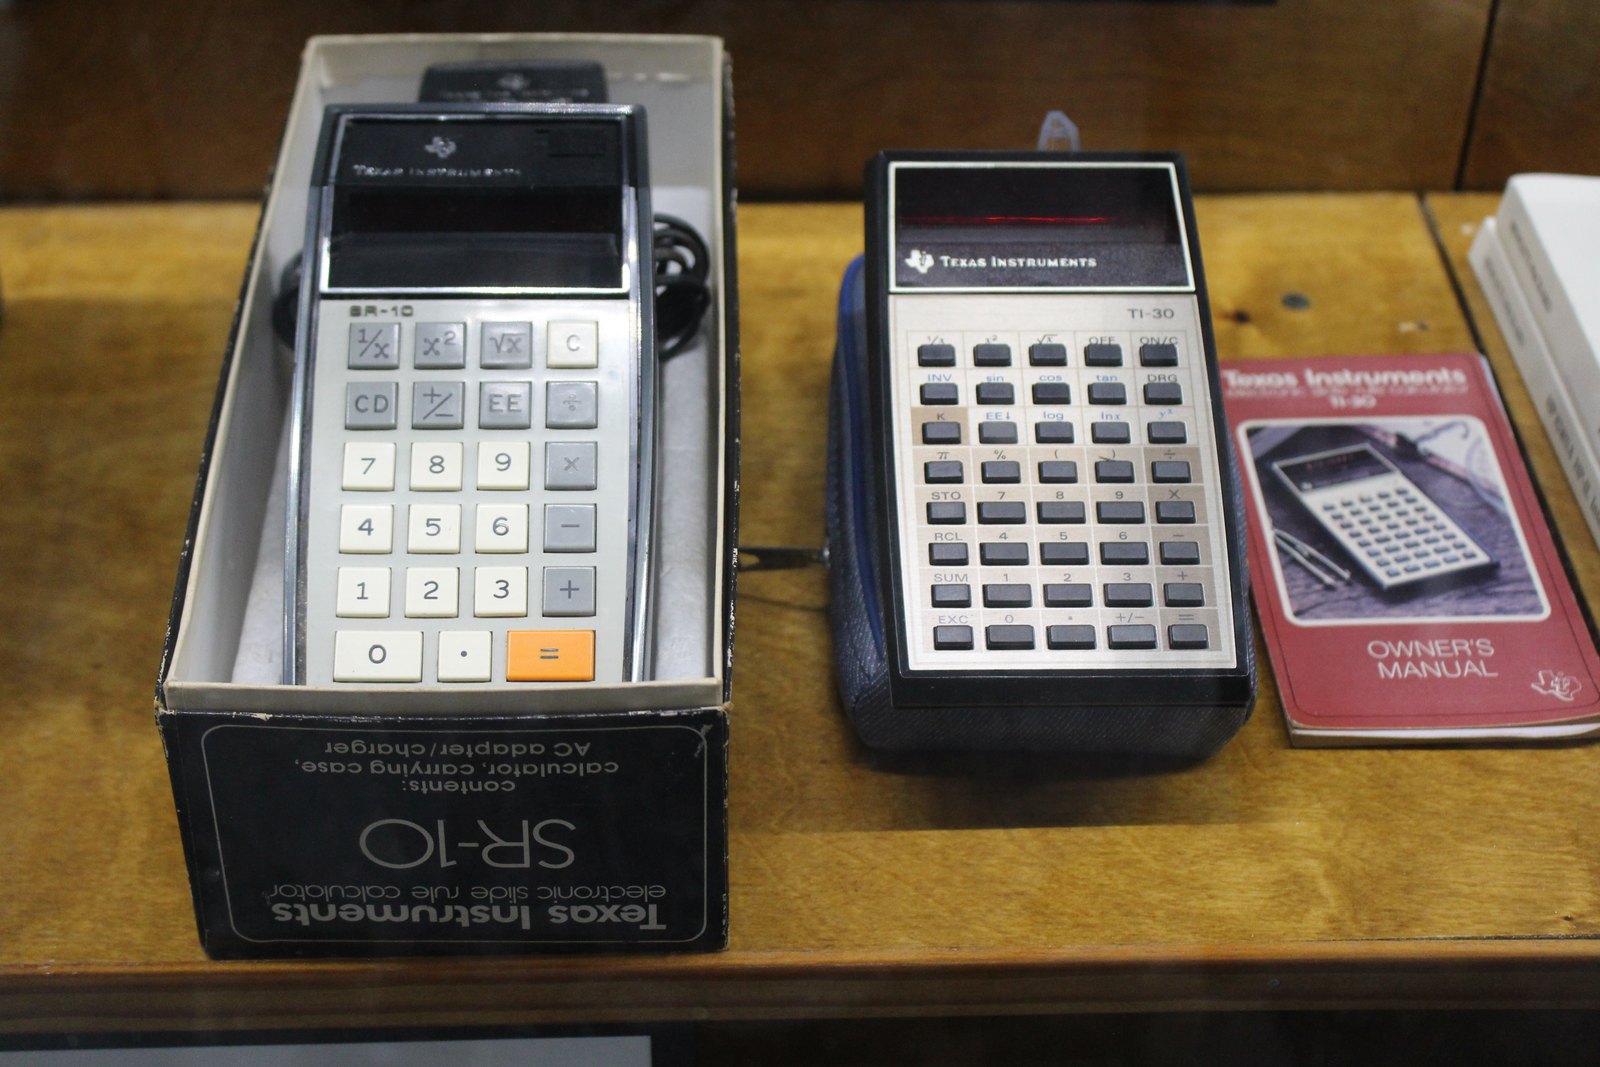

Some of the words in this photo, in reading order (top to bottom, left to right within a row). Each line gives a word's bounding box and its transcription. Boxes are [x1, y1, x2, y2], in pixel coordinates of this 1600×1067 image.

[940, 256, 986, 268] TEXAS
[991, 256, 1097, 268] INSTRUMENTS
[350, 305, 414, 317] SR-10
[1128, 308, 1174, 320] TI-30
[566, 334, 581, 352] C
[1088, 336, 1116, 345] OFF
[1139, 336, 1178, 346] ON/C
[927, 374, 952, 382] INV
[986, 374, 1004, 383] sin
[1039, 374, 1062, 382] cos
[1096, 374, 1118, 382] tan
[1147, 374, 1178, 383] DRG
[354, 394, 389, 414] CD
[488, 394, 522, 413] EE
[936, 412, 945, 420] K
[1043, 410, 1064, 422] log
[360, 458, 376, 475] 7
[428, 455, 446, 474] 8
[494, 453, 512, 472] 9
[931, 490, 962, 500] STO
[998, 491, 1006, 500] 7
[1055, 490, 1064, 500] 8
[1114, 490, 1124, 500] 9
[358, 518, 374, 536] 4
[425, 518, 441, 536] 5
[492, 516, 510, 536] 6
[934, 532, 964, 542] RCL
[999, 532, 1008, 540] 4
[1059, 531, 1068, 540] 5
[1118, 531, 1128, 540] 6
[934, 572, 969, 582] SUM
[1002, 573, 1010, 582] 1
[1063, 572, 1072, 582] 2
[1122, 572, 1132, 582] 3
[356, 582, 368, 600] 1
[424, 580, 440, 600] 2
[492, 579, 510, 599] 3
[938, 614, 969, 624] EXC
[1367, 638, 1495, 659] OWNER'S
[1377, 660, 1498, 679] MANUAL
[554, 742, 592, 756] AC
[294, 760, 363, 773] case,
[370, 760, 475, 778] carrying
[482, 762, 620, 777] calculator,
[402, 780, 516, 794] contents:
[359, 818, 576, 870] SR-10
[270, 884, 401, 902] calculator
[412, 886, 460, 904] rule
[470, 885, 529, 904] slide
[536, 884, 666, 902] electronic
[271, 902, 530, 930] Instruments
[548, 904, 667, 930] Texas
